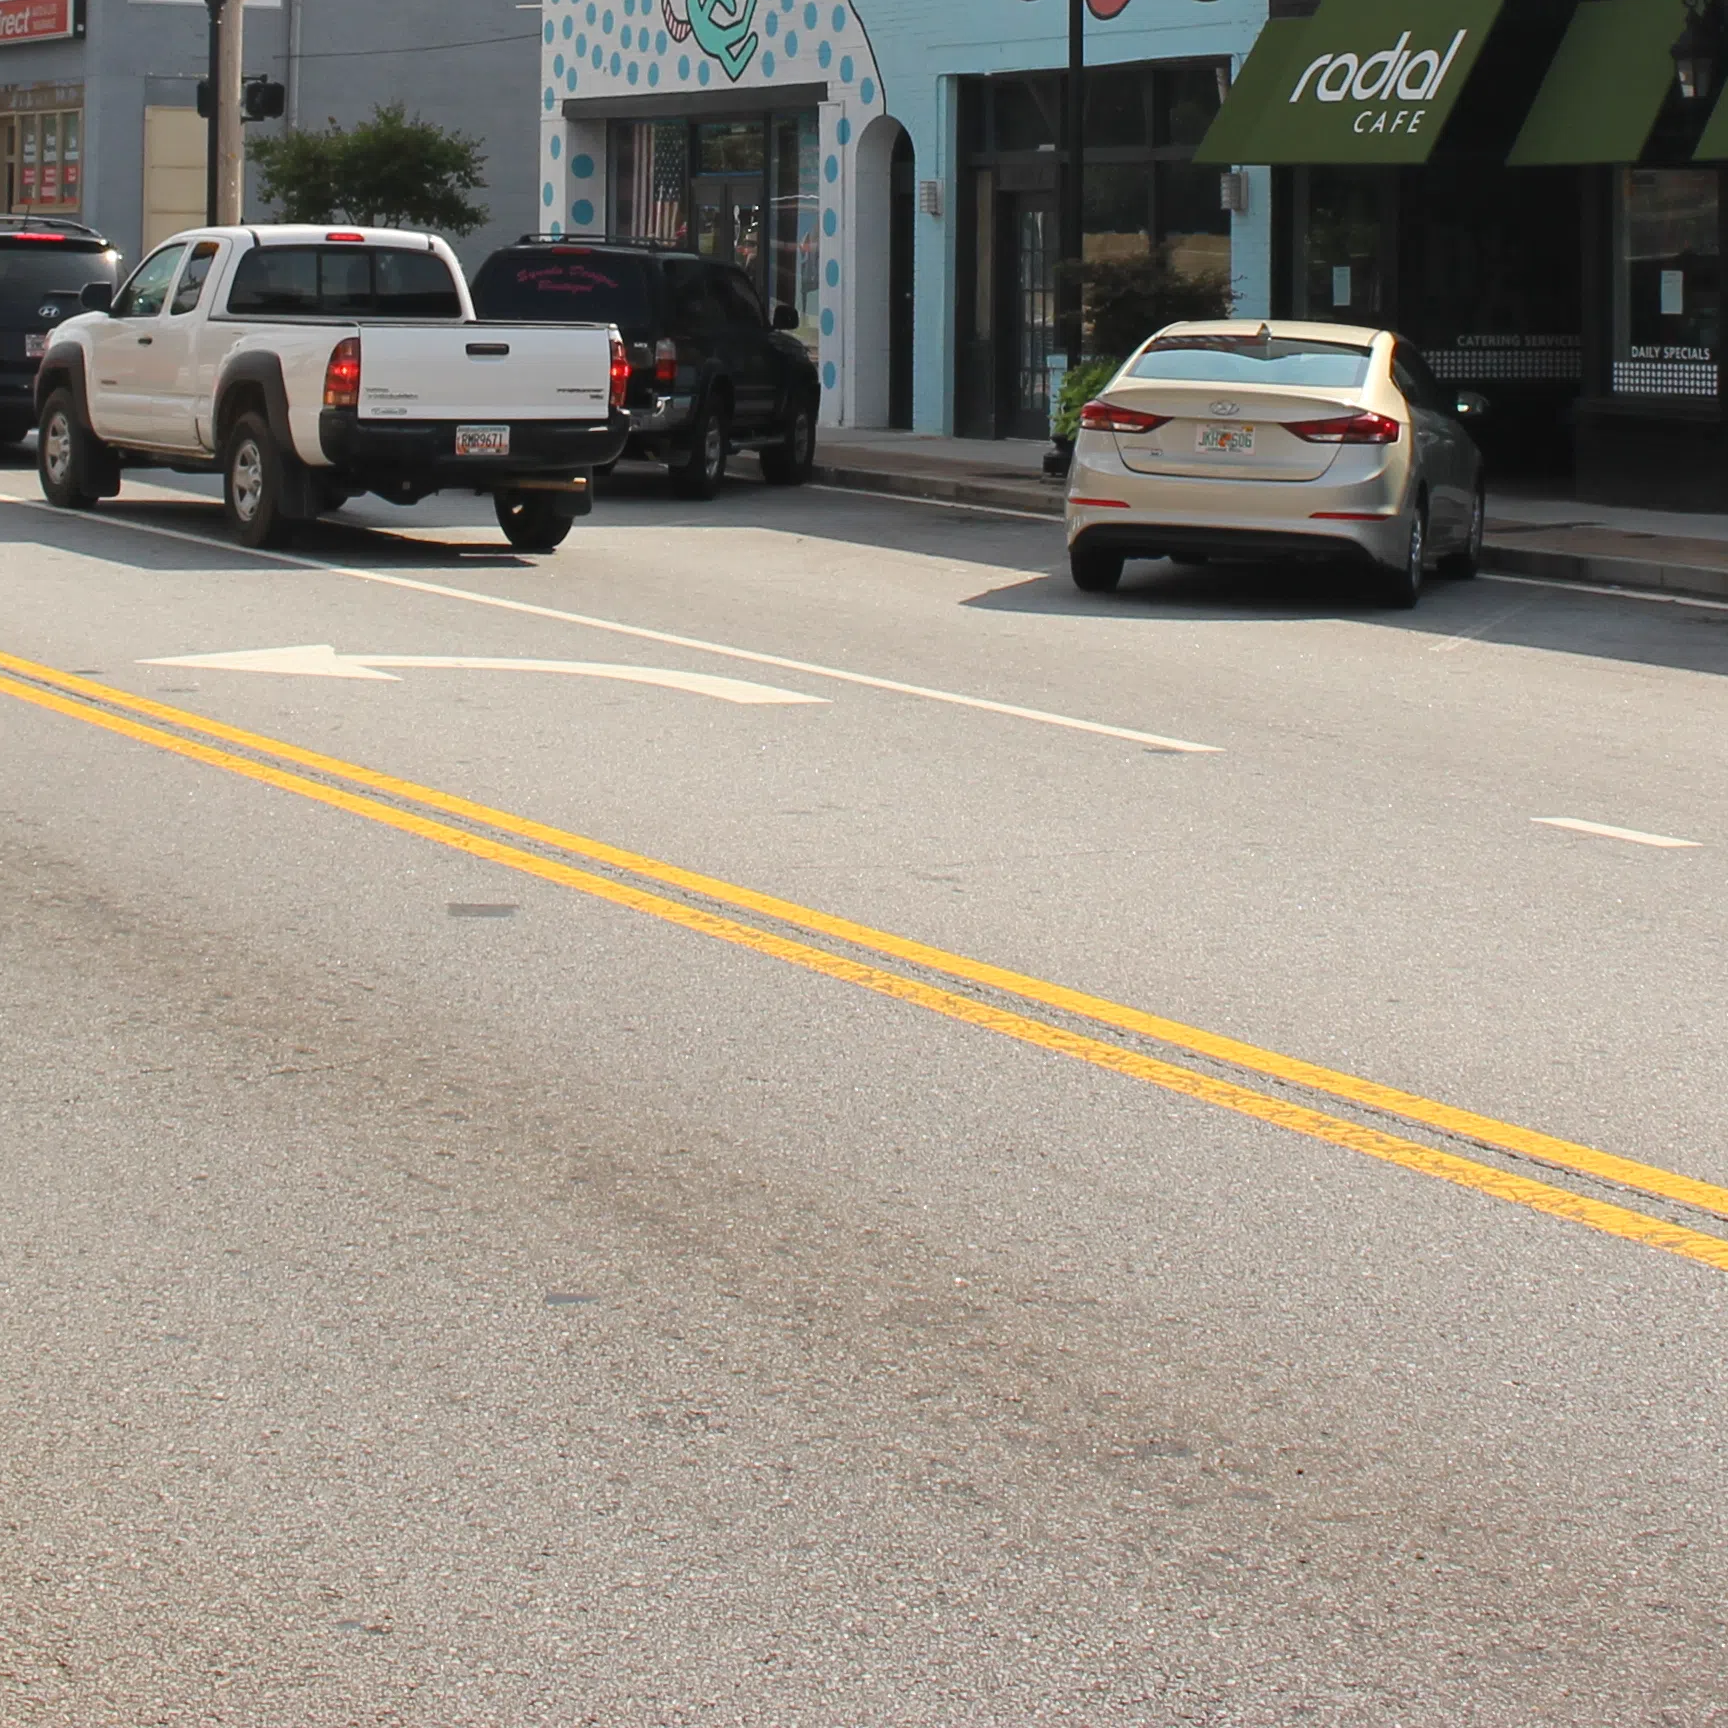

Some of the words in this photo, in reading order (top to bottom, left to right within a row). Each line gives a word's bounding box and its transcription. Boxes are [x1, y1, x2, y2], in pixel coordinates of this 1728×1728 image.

[1289, 29, 1468, 103] radial
[1353, 110, 1426, 134] CAFE
[1456, 334, 1521, 347] CATERING
[1631, 345, 1660, 359] DAILY
[1663, 347, 1711, 361] SPECIALS
